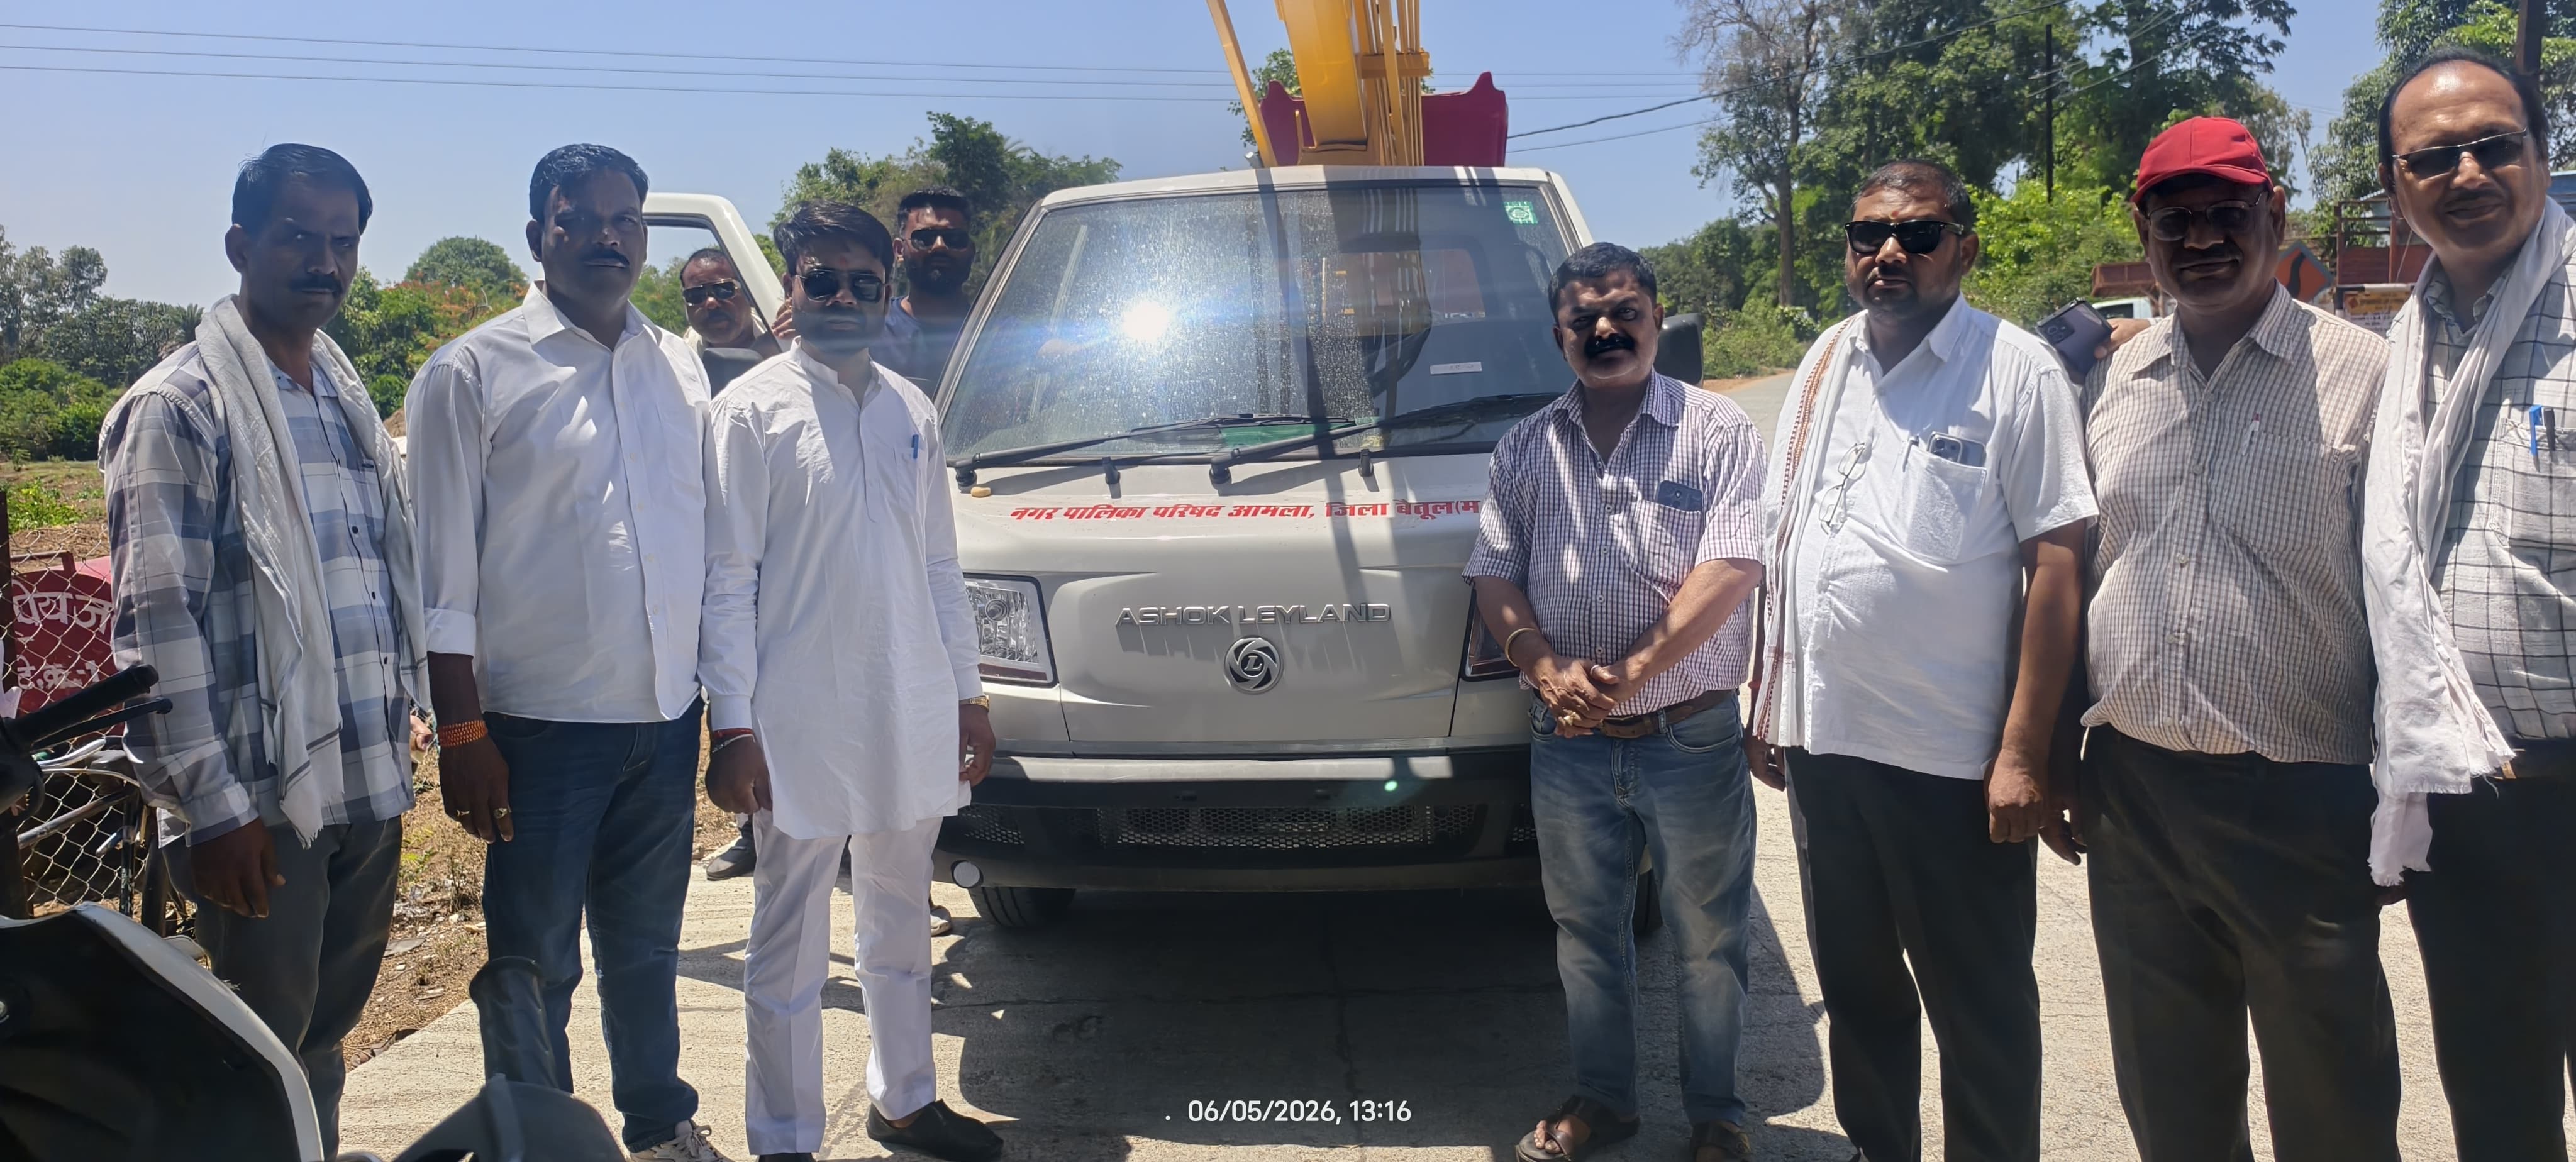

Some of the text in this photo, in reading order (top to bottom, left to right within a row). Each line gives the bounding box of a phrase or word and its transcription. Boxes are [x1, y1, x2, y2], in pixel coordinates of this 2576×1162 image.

[1010, 507, 1063, 520] नगर
[1063, 504, 1151, 519] पालिका
[1152, 503, 1226, 518] परिषद
[1227, 505, 1315, 519] आमला,
[1324, 502, 1389, 517] जिला
[1114, 603, 1392, 627] ASHOK LEYLAND
[1244, 655, 1263, 672] L
